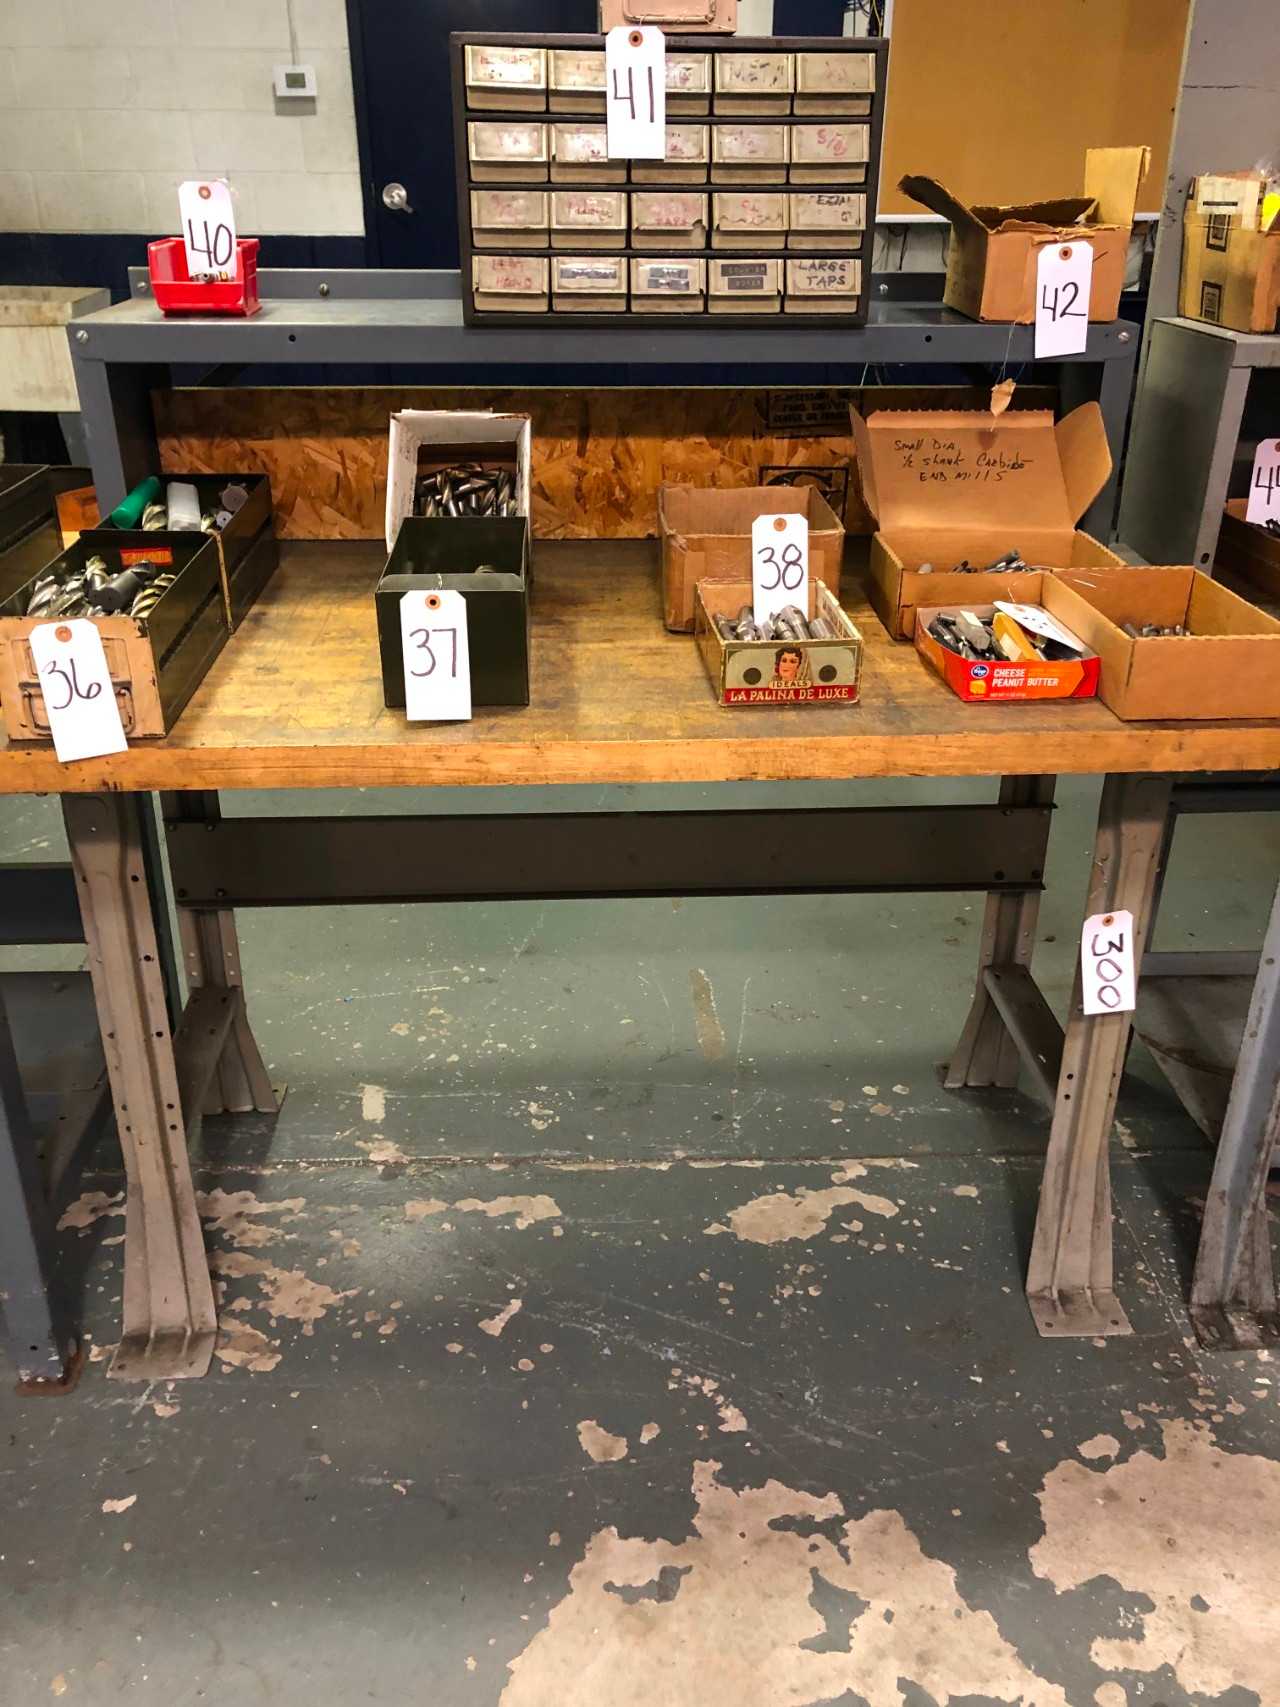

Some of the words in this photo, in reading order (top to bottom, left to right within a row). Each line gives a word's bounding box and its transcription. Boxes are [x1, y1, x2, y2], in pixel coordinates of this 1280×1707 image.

[612, 65, 656, 124] 41
[187, 217, 234, 268] 40
[799, 259, 850, 272] LARGE
[806, 274, 847, 287] TAPS
[1041, 281, 1088, 323] 42
[756, 544, 805, 591] 38
[409, 627, 458, 678] 37
[993, 668, 1026, 678] CHEESE
[41, 659, 102, 710] 36
[730, 690, 747, 702] LA
[750, 688, 796, 701] PALINA
[798, 688, 814, 700] DE
[818, 687, 849, 700] LUXE
[991, 677, 1025, 688] PEANUT
[1026, 677, 1059, 687] BUTTER
[1091, 932, 1124, 1009] 300
